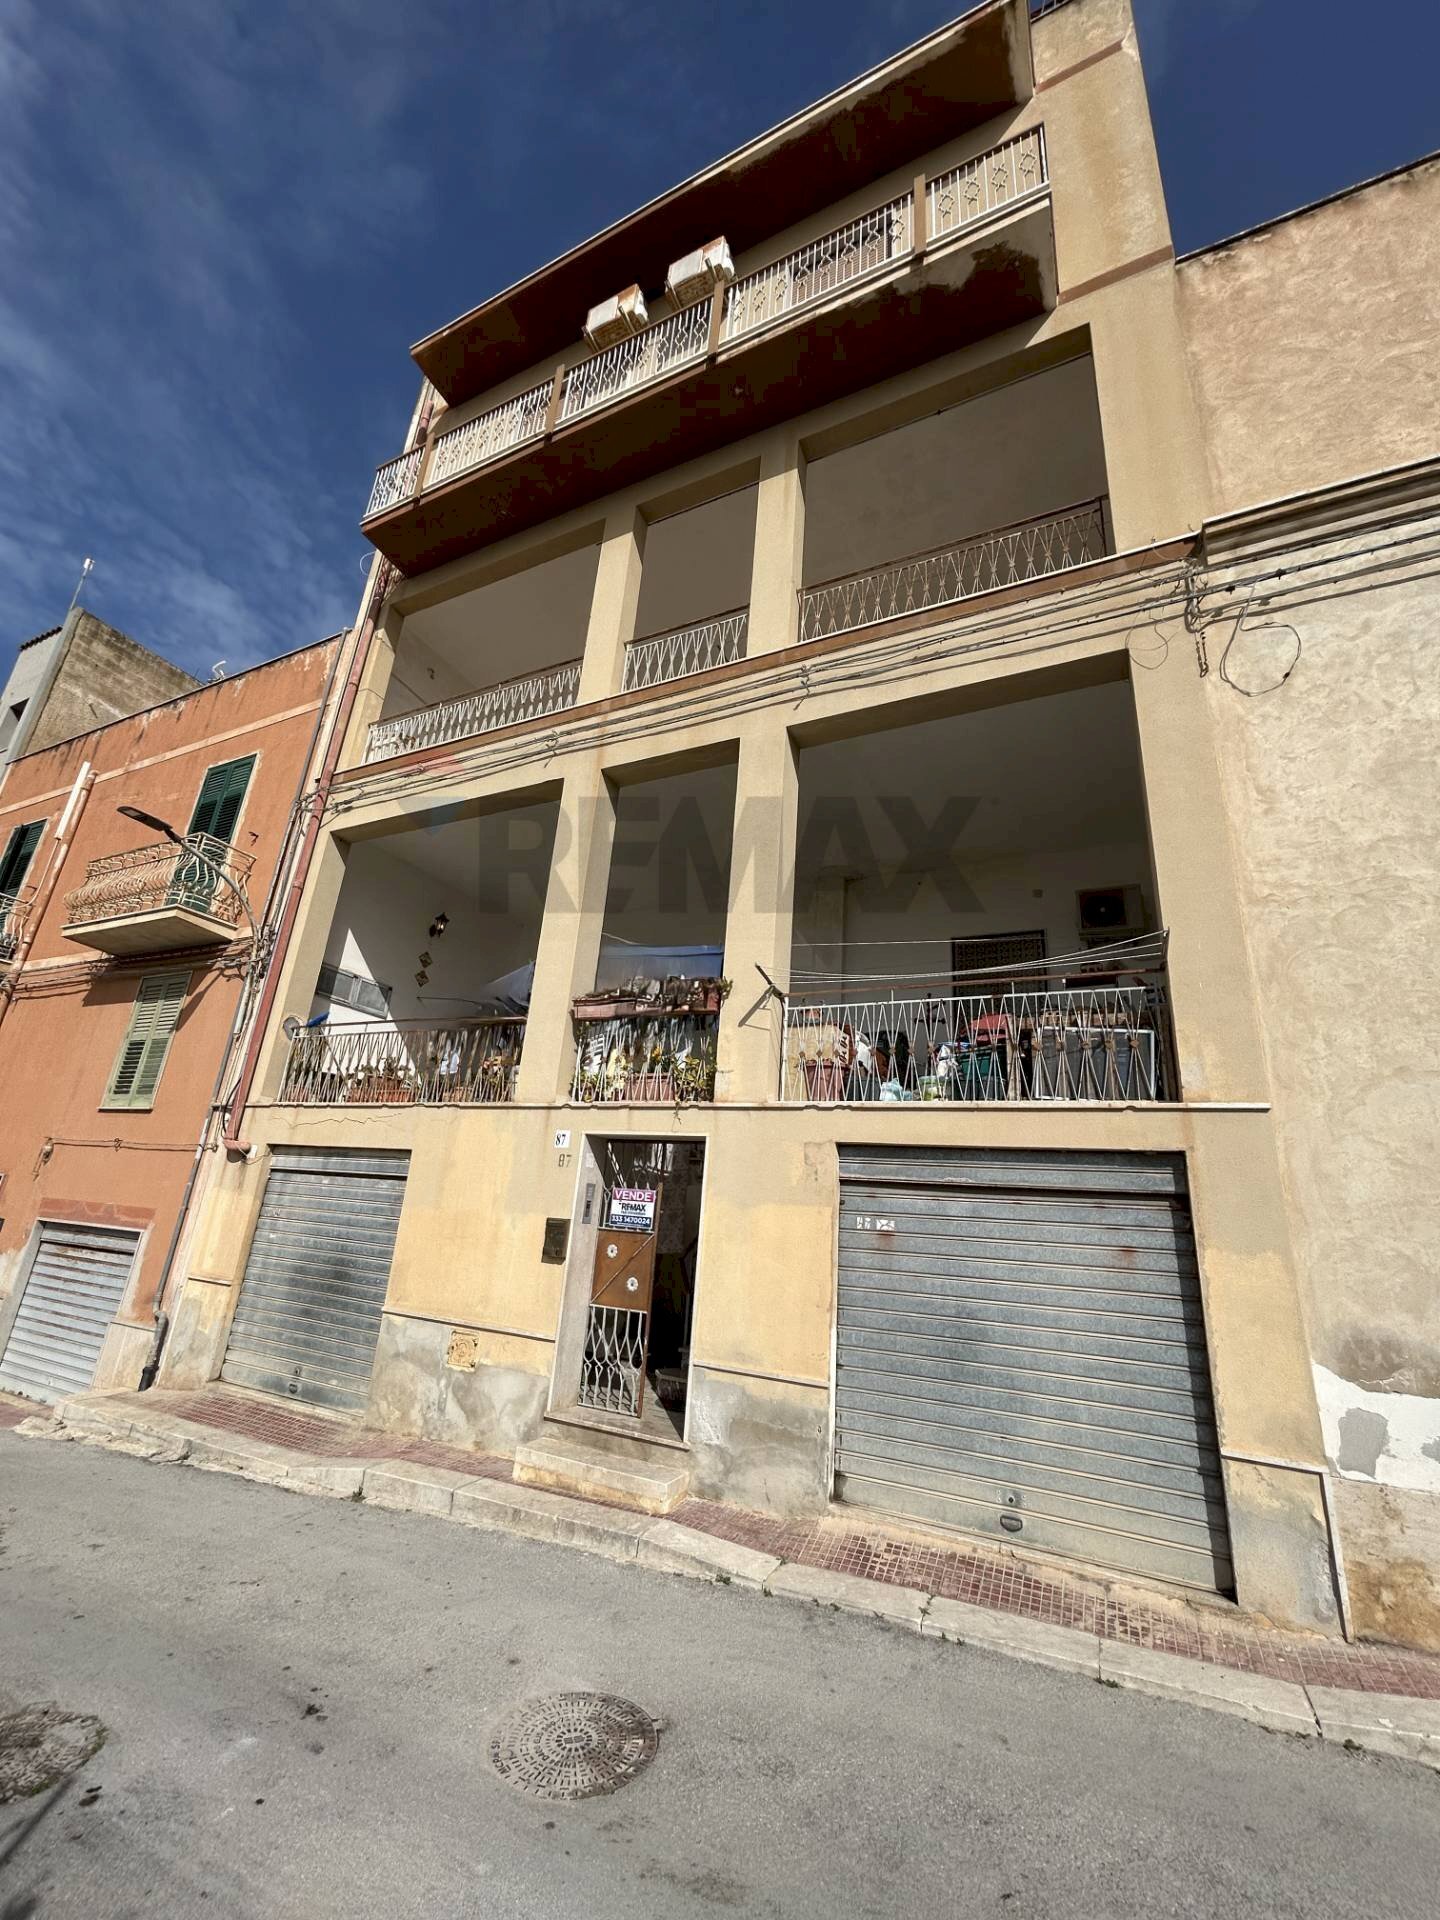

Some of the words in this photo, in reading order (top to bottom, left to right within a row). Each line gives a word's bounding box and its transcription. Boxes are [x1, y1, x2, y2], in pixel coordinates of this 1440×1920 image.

[555, 1133, 567, 1146] 87
[558, 1153, 572, 1167] 87
[615, 1190, 652, 1201] VENDE
[623, 1216, 650, 1224] 1470024
